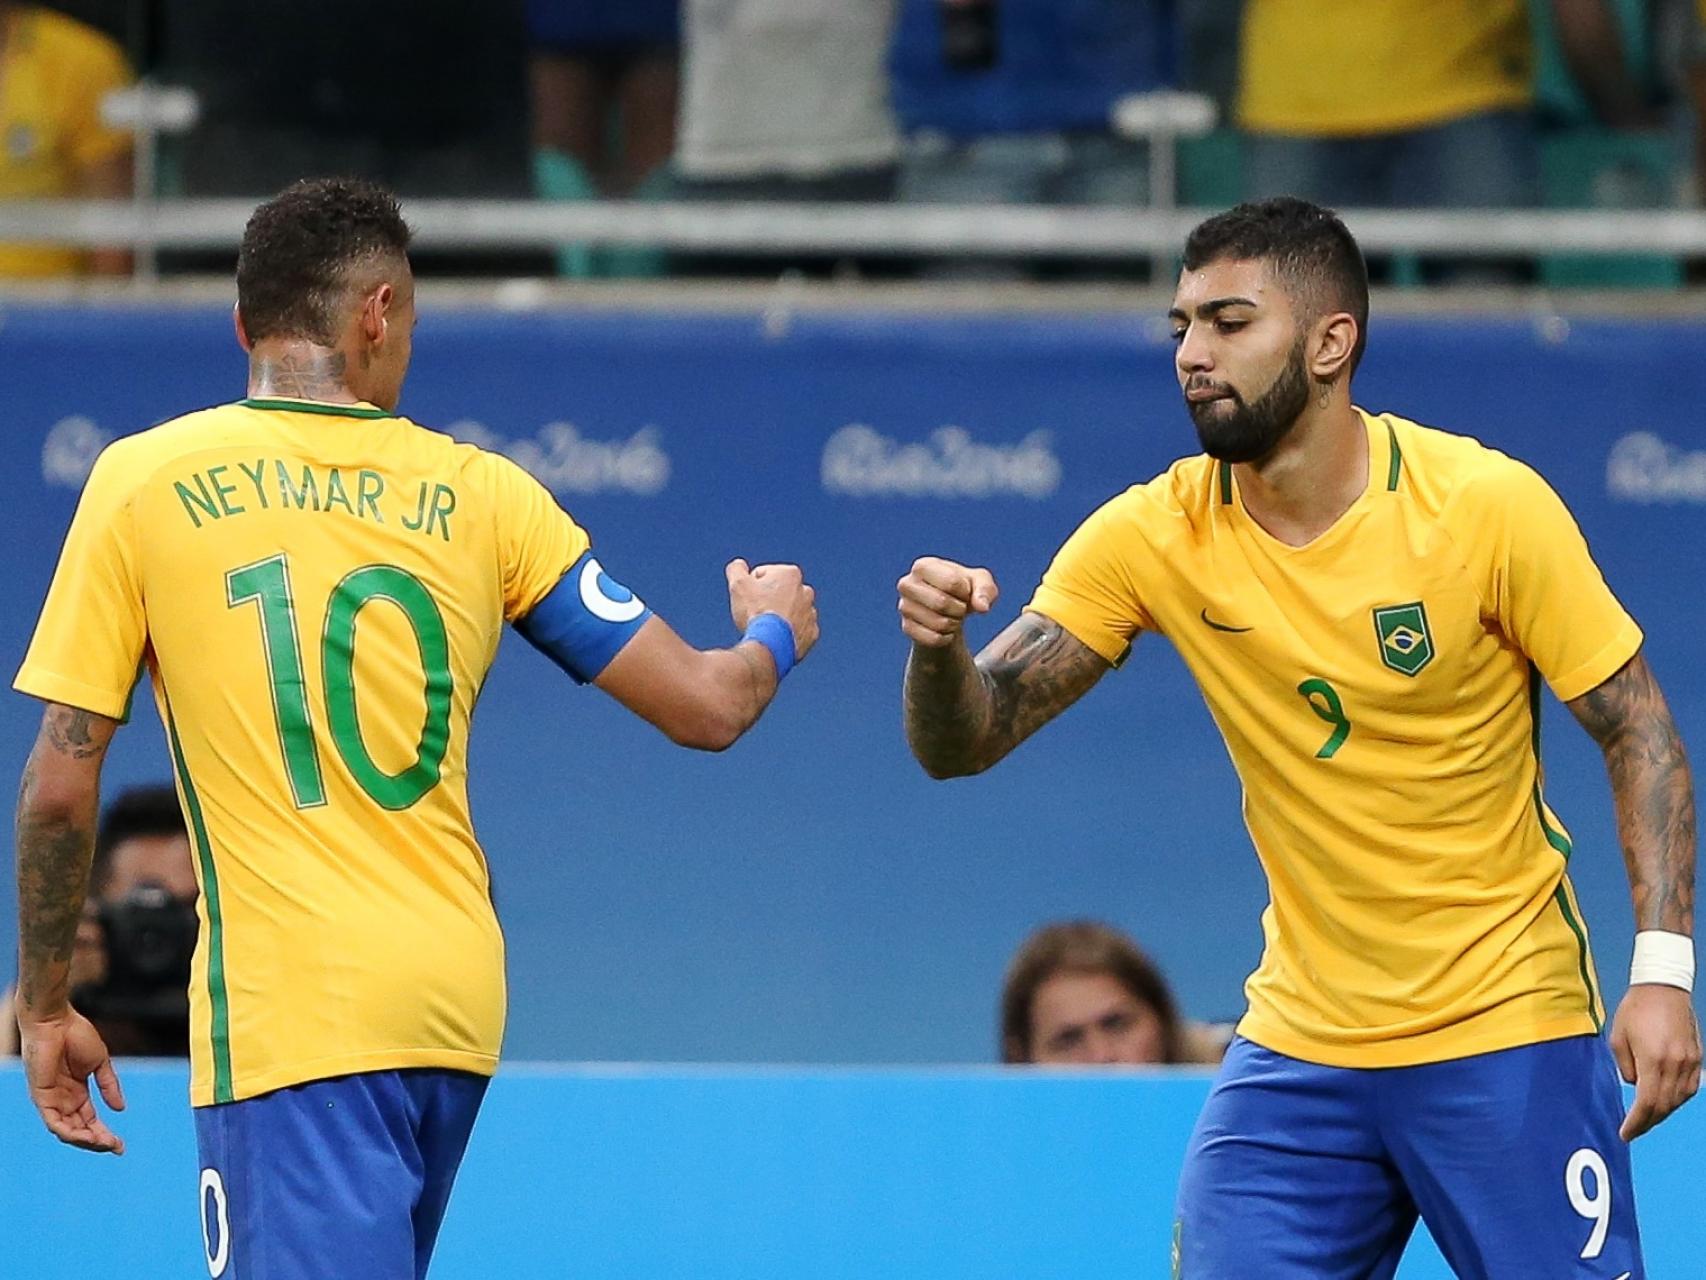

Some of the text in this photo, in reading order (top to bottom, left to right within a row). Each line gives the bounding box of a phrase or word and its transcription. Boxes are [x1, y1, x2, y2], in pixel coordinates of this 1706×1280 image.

[173, 458, 456, 542] NEYMAR JR
[226, 553, 453, 811] 10
[1297, 678, 1351, 758] 9
[1564, 1147, 1612, 1260] 9
